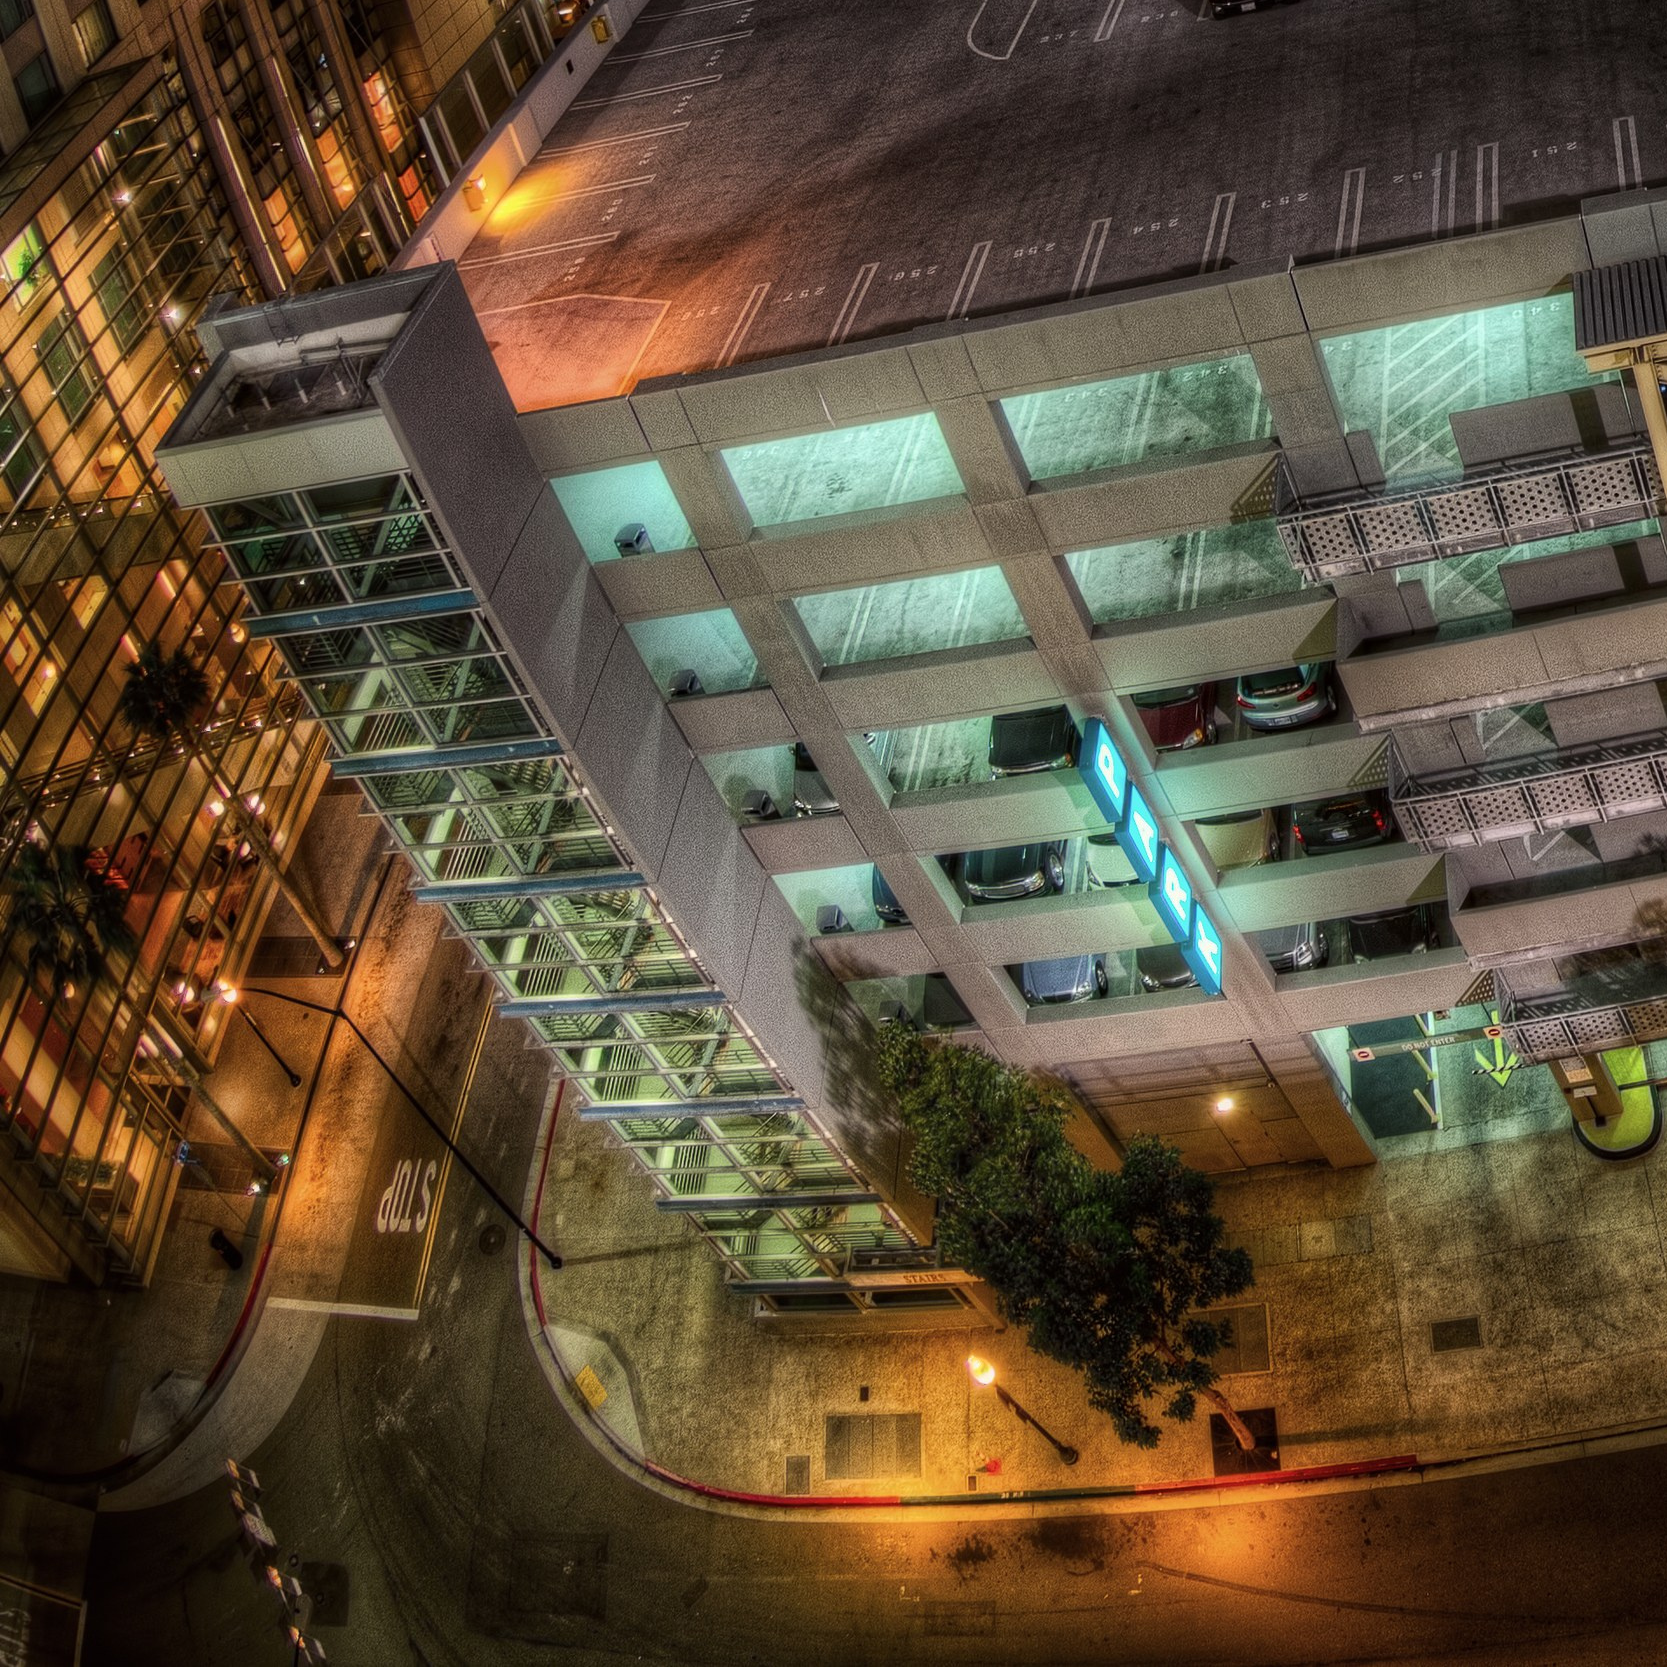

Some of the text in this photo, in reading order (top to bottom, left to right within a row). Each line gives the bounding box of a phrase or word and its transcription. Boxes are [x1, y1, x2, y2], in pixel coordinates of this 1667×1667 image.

[1530, 140, 1577, 158] 251
[1391, 165, 1442, 185] 252
[1259, 190, 1309, 210] 253
[1131, 216, 1179, 235] 254
[1011, 241, 1056, 258] 255
[891, 264, 938, 281] 256
[781, 284, 827, 302] 257
[1512, 300, 1560, 320] 340
[1181, 364, 1228, 382] 342
[1063, 385, 1108, 402] 343
[1095, 742, 1218, 974] PARK
[1401, 1036, 1456, 1051] DO NOT ENTER
[377, 1158, 437, 1233] STOP
